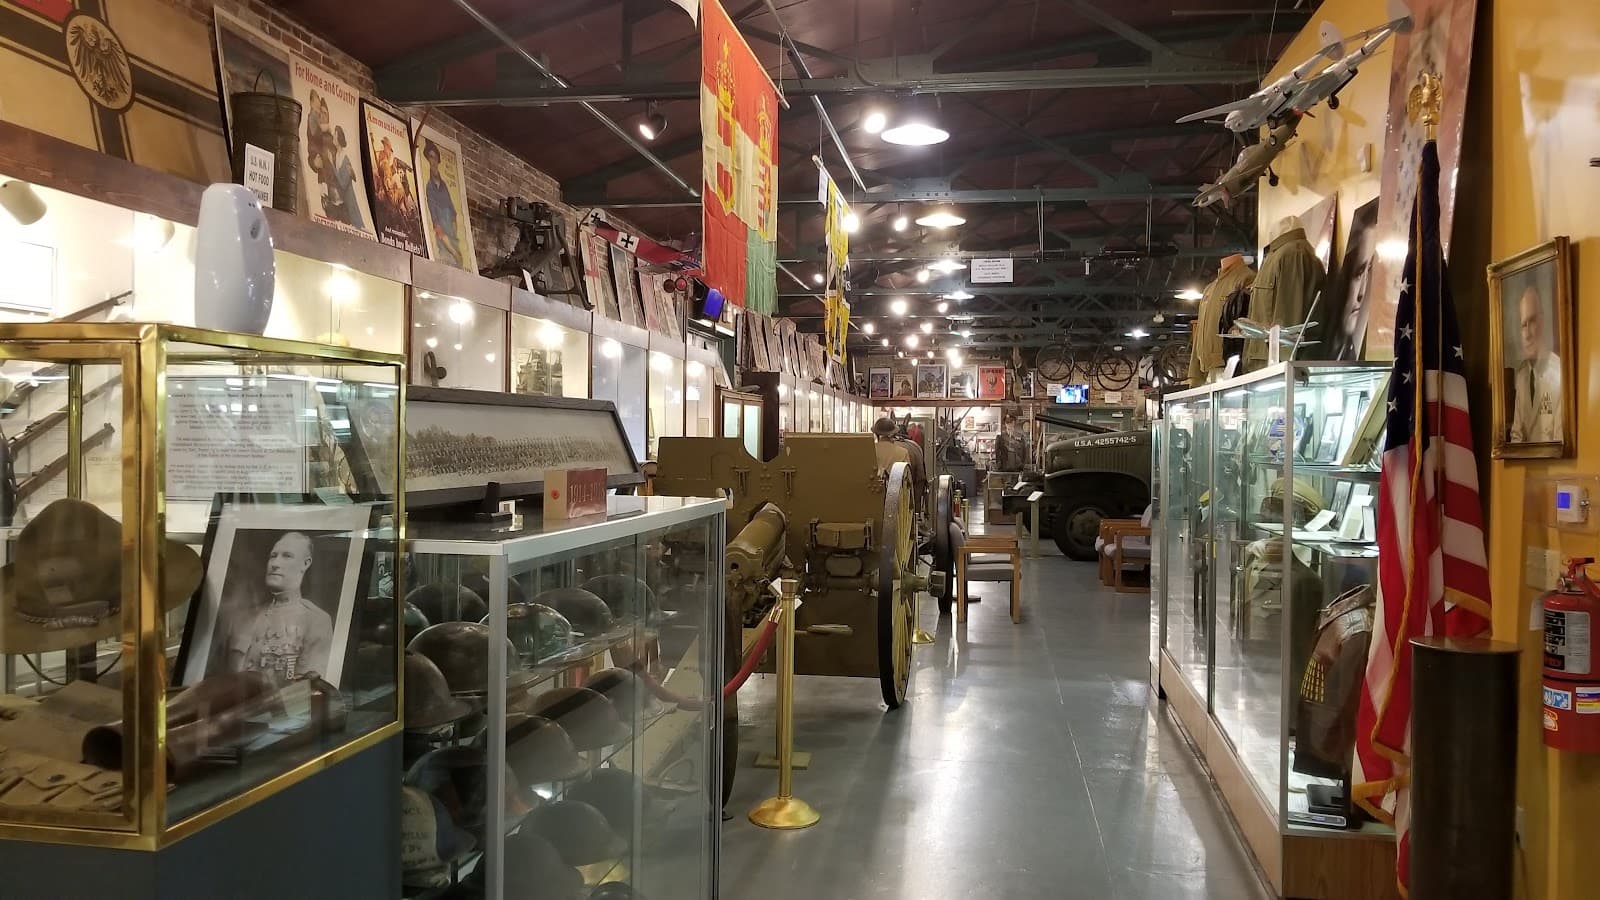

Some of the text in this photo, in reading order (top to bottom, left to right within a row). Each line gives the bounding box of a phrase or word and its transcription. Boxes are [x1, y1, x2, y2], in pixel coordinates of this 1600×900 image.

[295, 62, 356, 106] For Home and Country
[249, 170, 269, 186] HOT FOOD
[1074, 440, 1094, 448] U.S.A.
